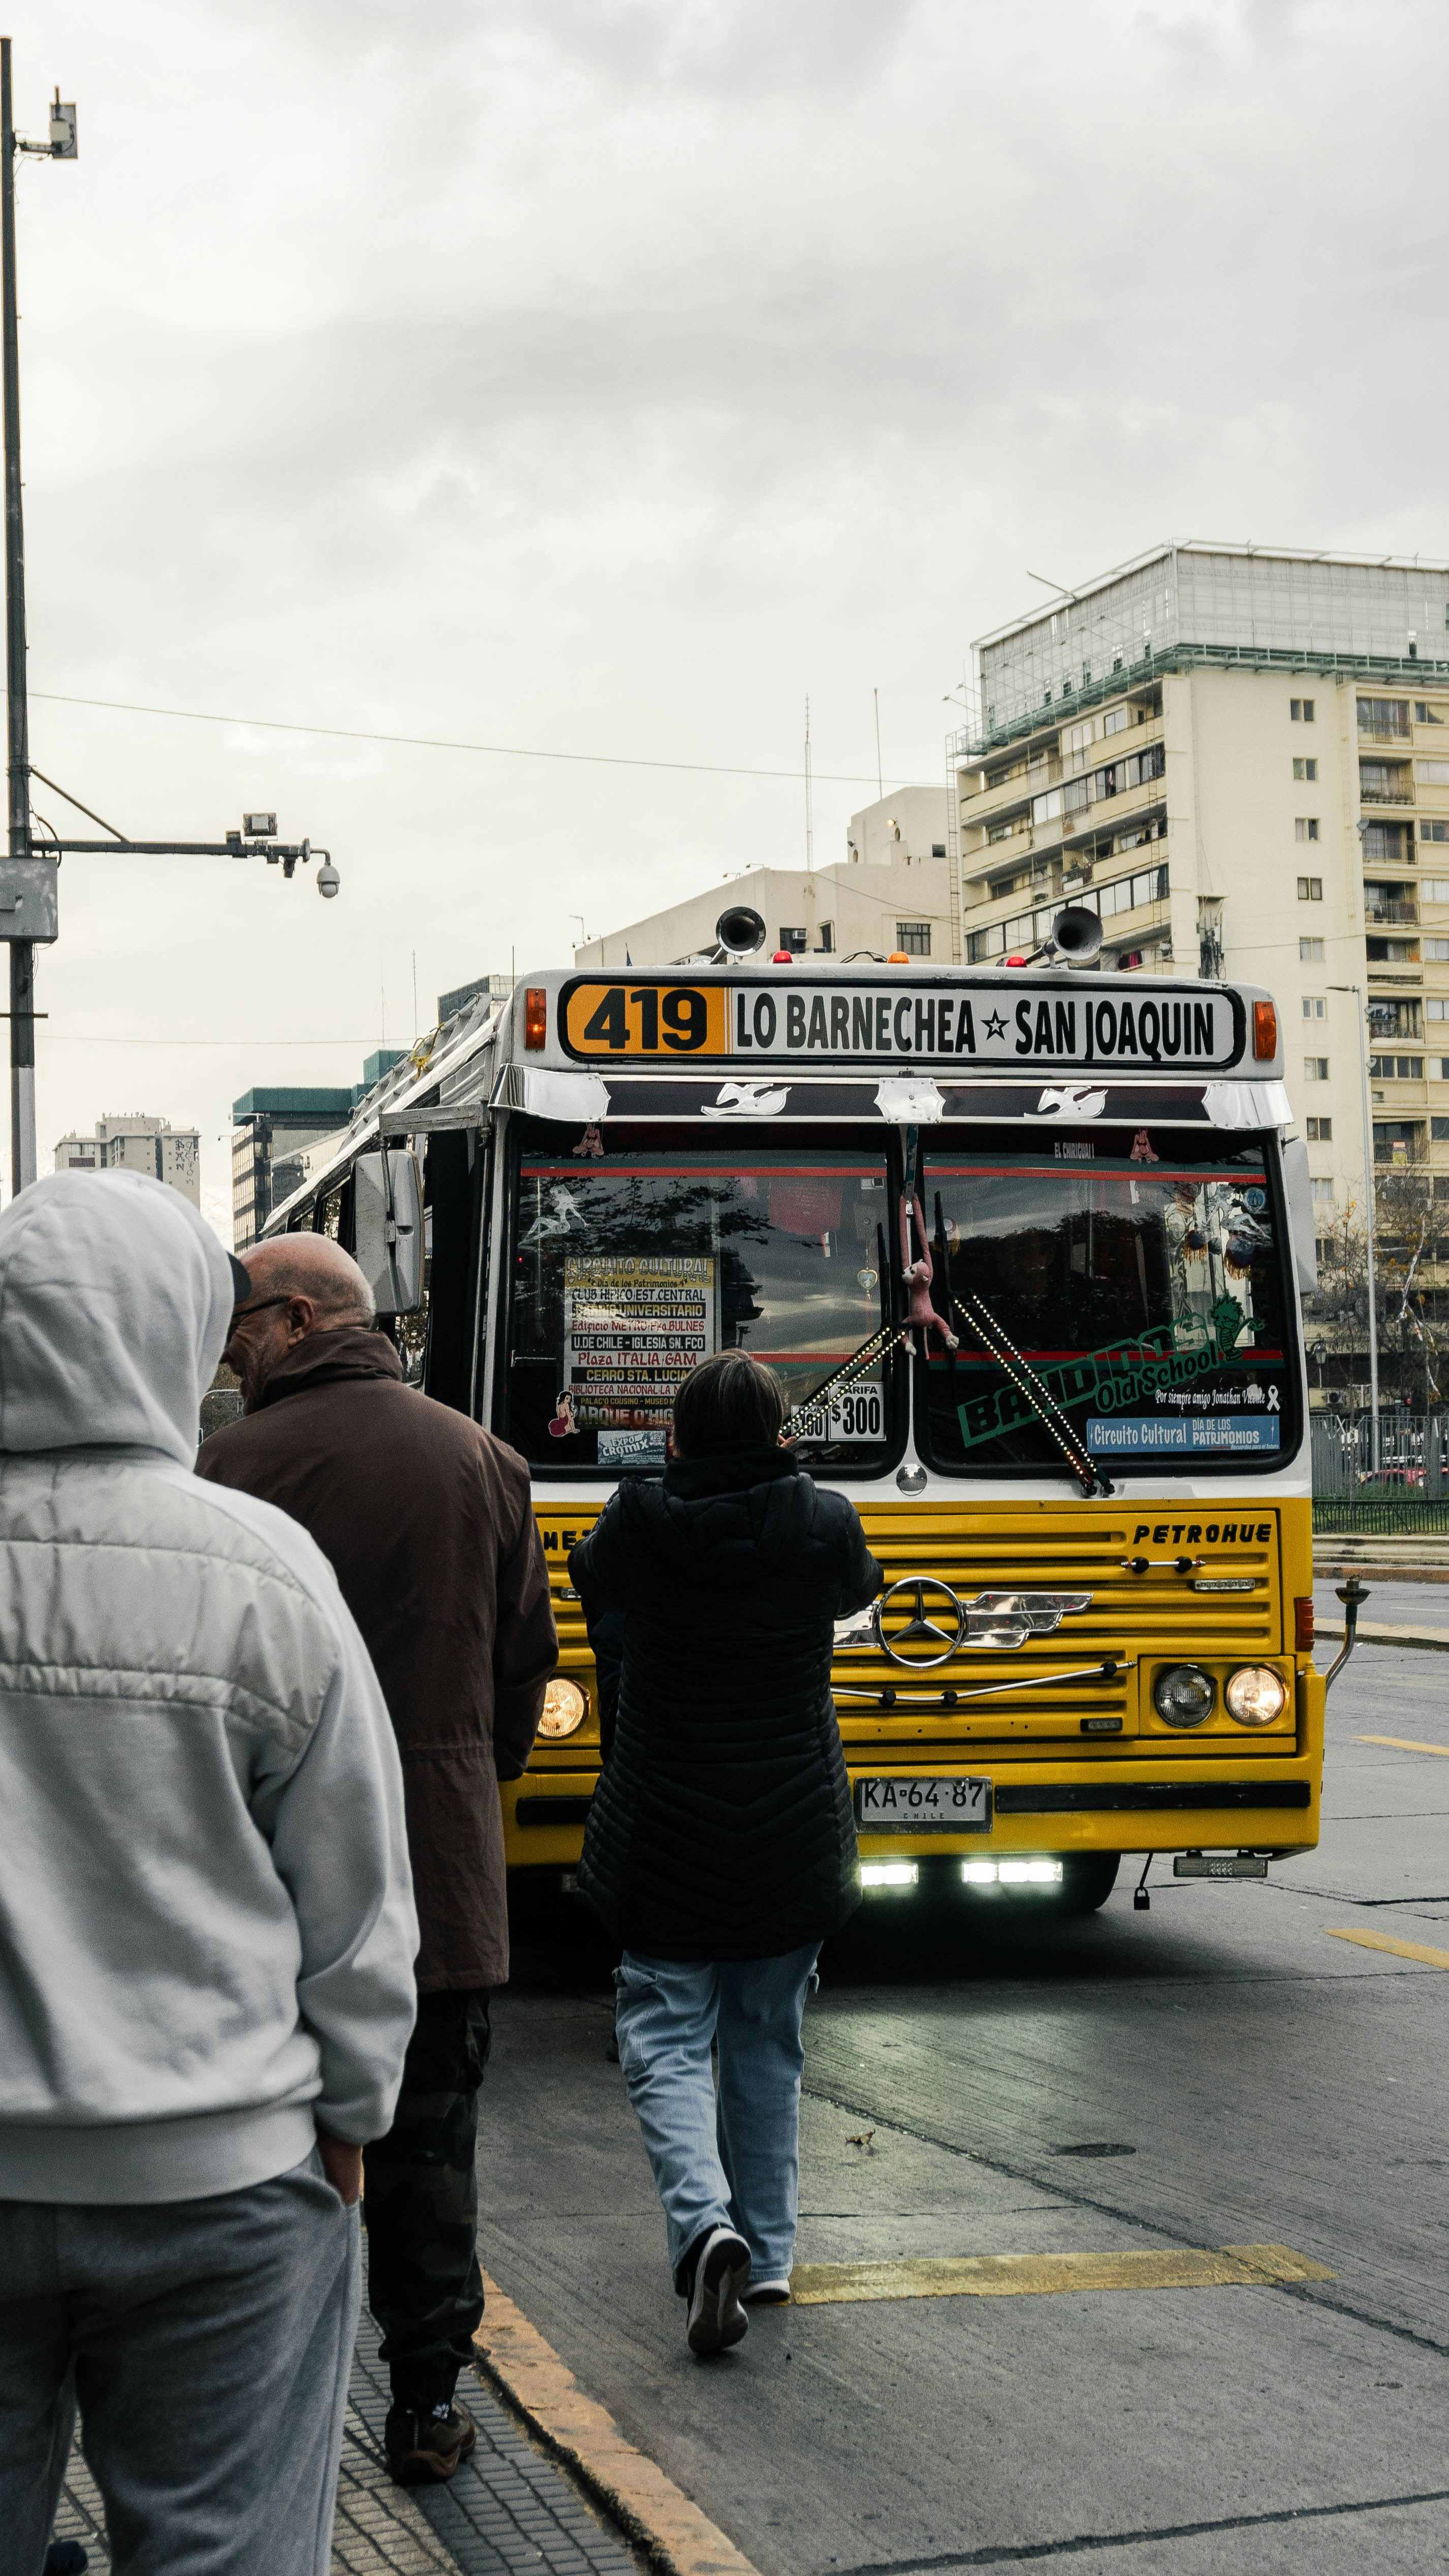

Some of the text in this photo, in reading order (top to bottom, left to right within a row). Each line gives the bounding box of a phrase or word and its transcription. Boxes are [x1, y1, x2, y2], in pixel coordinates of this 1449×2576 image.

[584, 988, 1214, 1061] 419 LO BARNECHEA SAN JOAQUIN
[1055, 1142, 1061, 1158] EL
[566, 1257, 711, 1284] CIRCUITO CULTURAL
[611, 1278, 619, 1287] de
[621, 1279, 632, 1287] los
[634, 1279, 678, 1288] Patrimonios
[572, 1288, 597, 1300] CLUB
[619, 1304, 703, 1317] UNIVERSITARIO
[572, 1320, 609, 1333] Edificio
[596, 1337, 623, 1349] CHILE
[632, 1337, 667, 1349] IGLESIA
[669, 1337, 683, 1349] SN.
[685, 1337, 704, 1349] FCO
[578, 1351, 697, 1366] Plaza ITALIA GAM
[586, 1369, 686, 1382] CERRO STA. LUCIA
[958, 1313, 1209, 1447] BANDIDOS
[1096, 1341, 1218, 1410] Old School
[569, 1384, 614, 1395] BIBLIOTECA
[617, 1384, 658, 1395] NACIONAL
[659, 1385, 671, 1395] LA
[645, 1397, 669, 1406] MUSEO
[1155, 1389, 1168, 1404] Por
[1169, 1390, 1191, 1410] siempre
[1192, 1390, 1211, 1410] amigo
[1212, 1388, 1240, 1406] Jonathan
[577, 1405, 631, 1425] ARQUE
[831, 1396, 880, 1435] $300
[1192, 1419, 1231, 1431] DÍA DE LOS
[612, 1436, 635, 1447] EXPO
[1094, 1423, 1187, 1445] Circuito Cultural
[1192, 1430, 1259, 1445] PATRIMONIOS
[1132, 1523, 1272, 1544] PETROHUE
